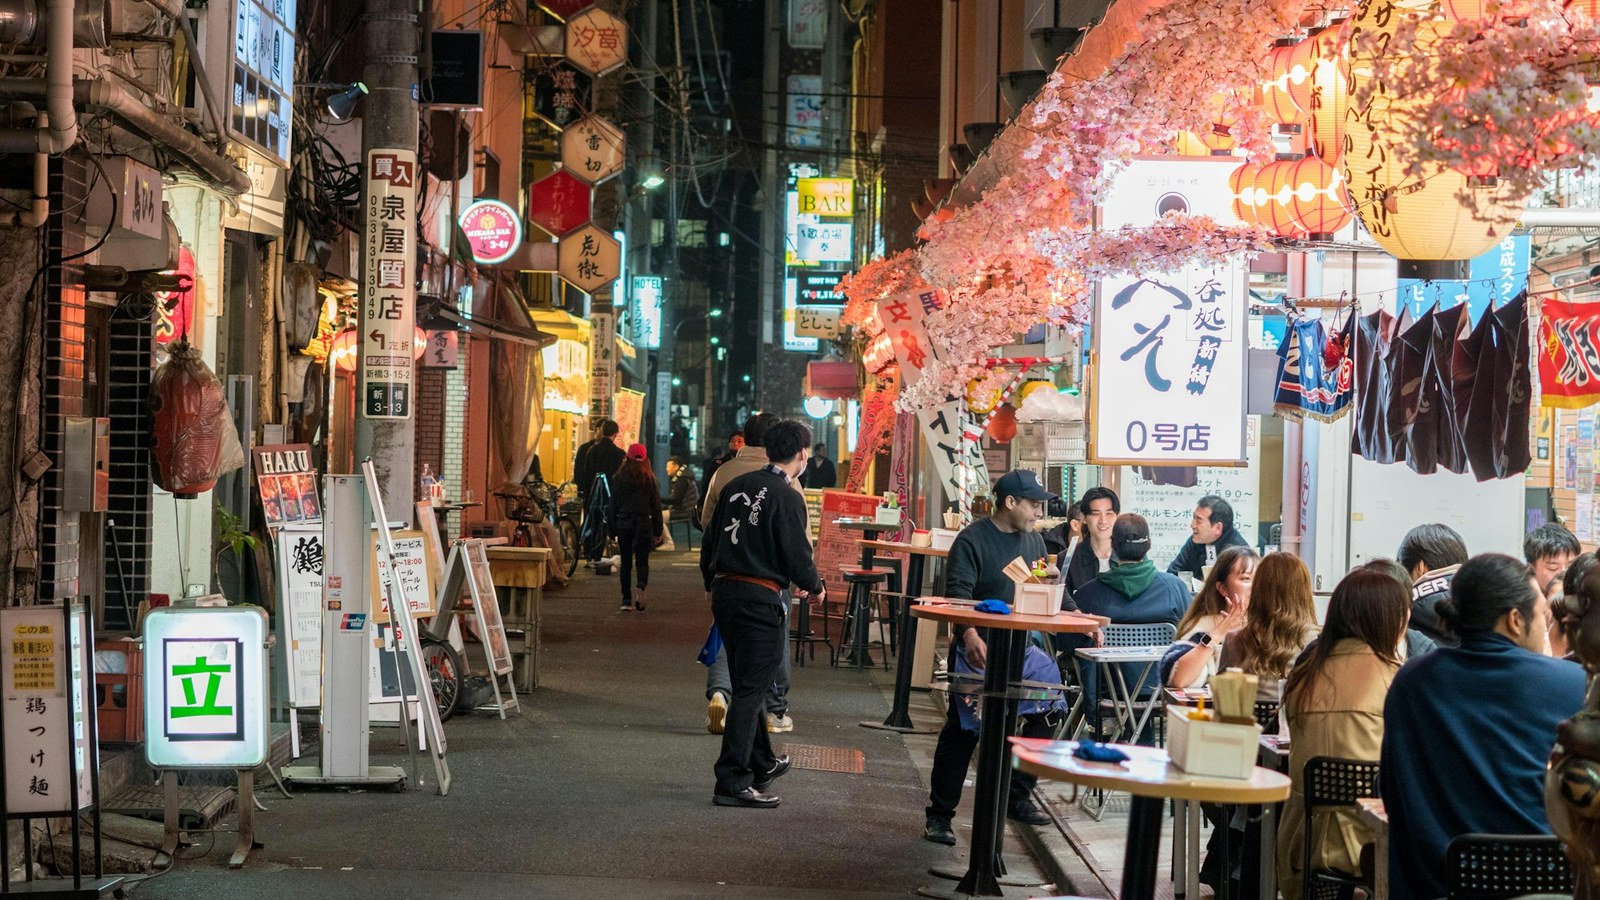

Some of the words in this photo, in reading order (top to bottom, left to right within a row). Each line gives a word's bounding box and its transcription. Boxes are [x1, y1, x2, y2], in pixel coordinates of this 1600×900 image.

[573, 26, 619, 50] 汐音
[585, 135, 602, 172] 雷切
[375, 158, 411, 184] 買入
[549, 175, 567, 232] まわり道
[803, 195, 847, 212] BAR
[378, 194, 406, 320] 泉屋質店
[577, 234, 605, 280] 虎徹
[634, 279, 661, 289] HOTEL
[1412, 284, 1426, 322] ビー
[800, 316, 834, 330] としこ
[1111, 278, 1193, 393] へそ
[373, 390, 404, 401] 新橋
[374, 402, 402, 413] 3-13
[260, 450, 310, 474] HARU
[724, 492, 752, 545] へそ
[375, 540, 422, 551] タサービス
[1208, 551, 1214, 560] 2
[18, 626, 50, 634] この奥
[171, 656, 233, 718] 立
[26, 697, 49, 797] 鶏つけ麺
